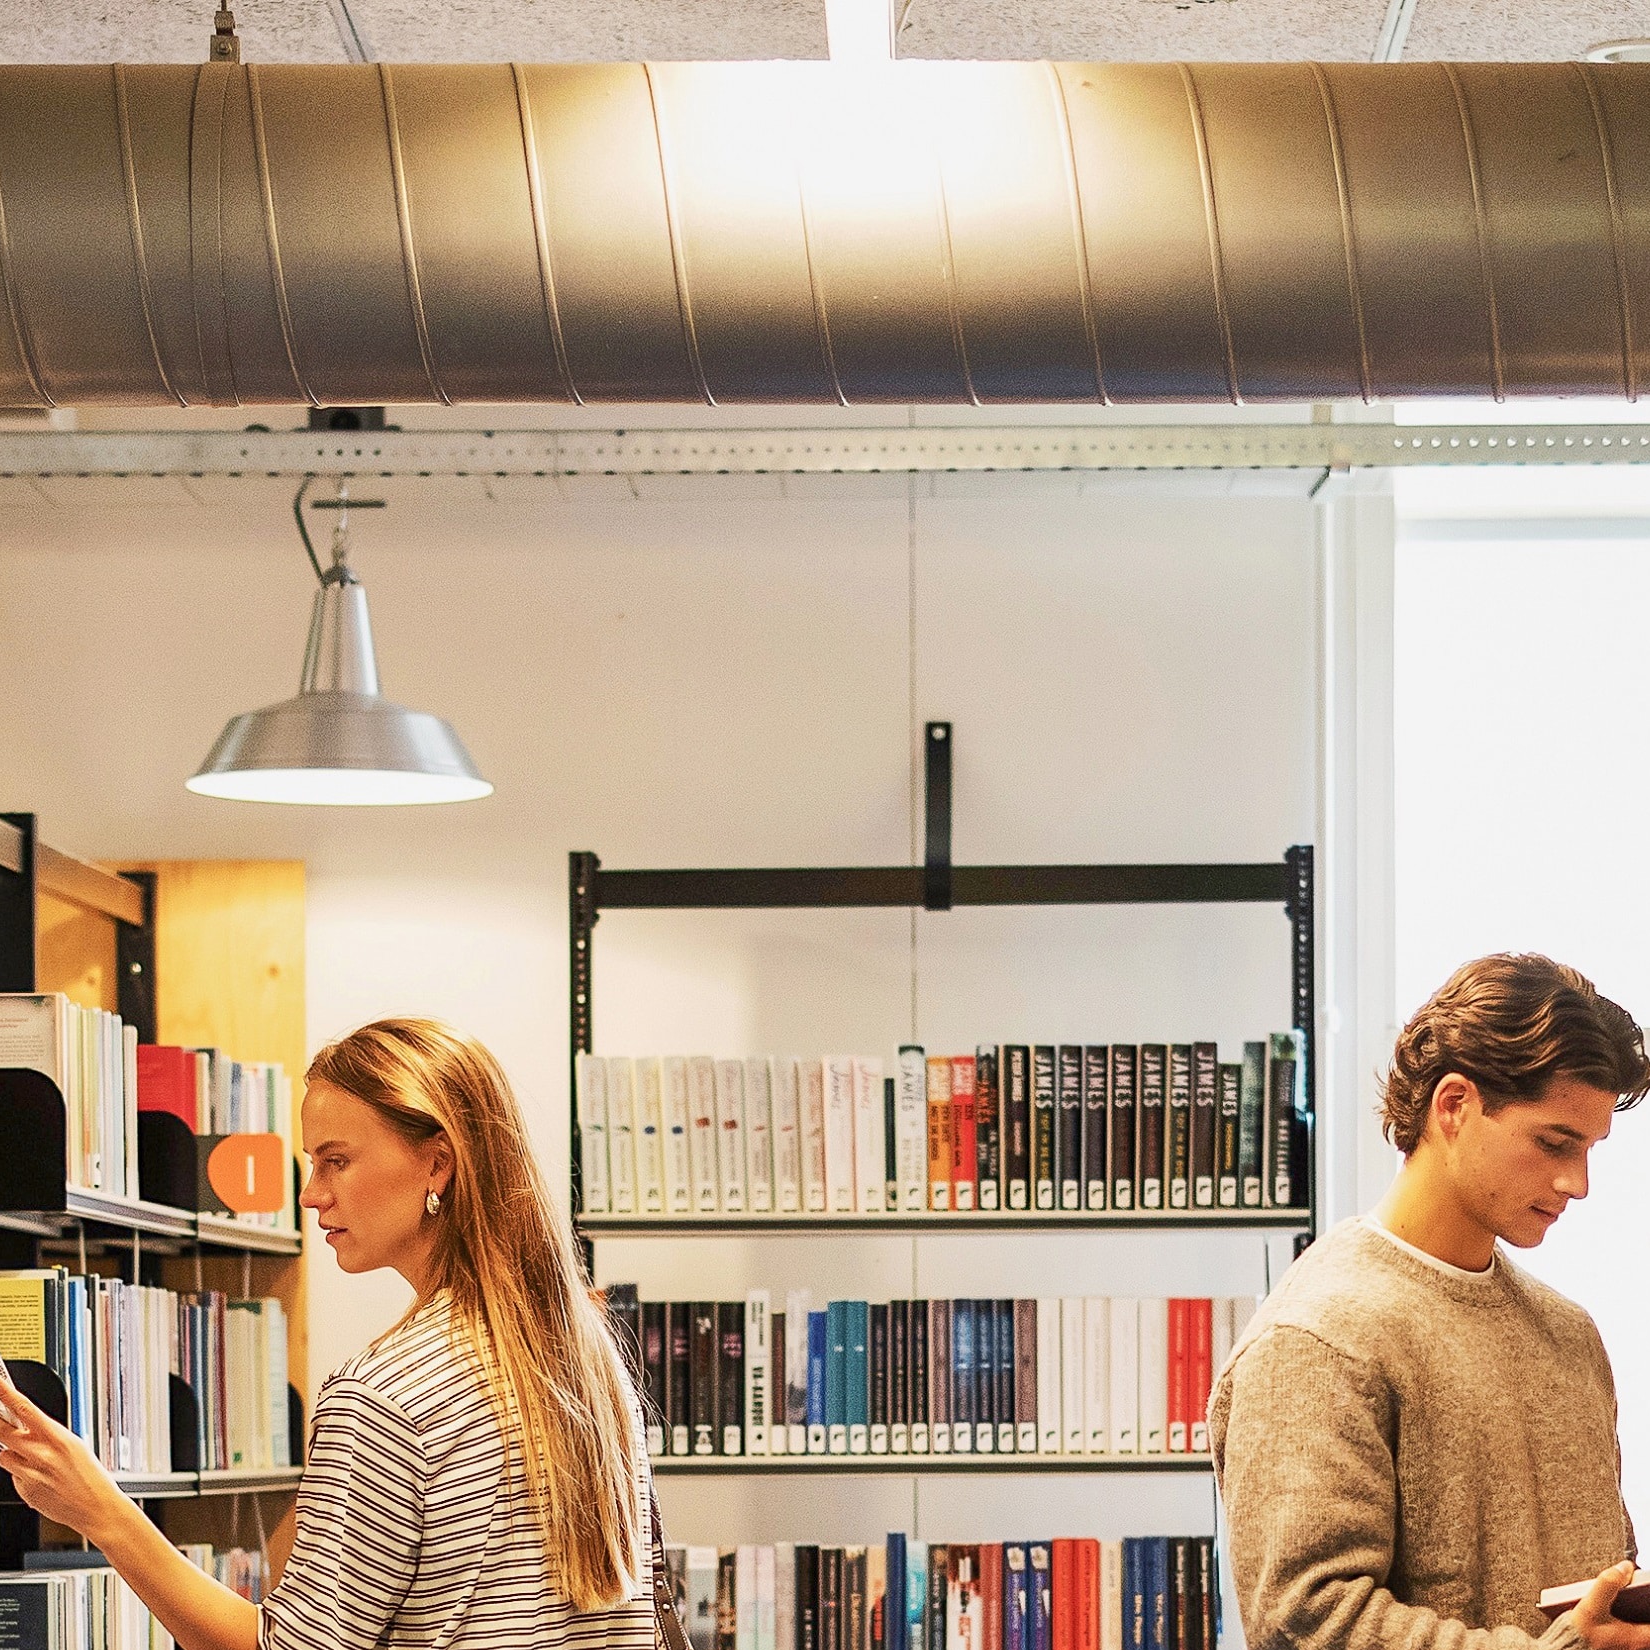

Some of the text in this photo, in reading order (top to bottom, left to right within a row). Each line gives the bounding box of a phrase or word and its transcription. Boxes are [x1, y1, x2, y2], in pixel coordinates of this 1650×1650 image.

[1036, 1054, 1053, 1109] JAMES
[1062, 1054, 1079, 1110] JAMES
[1088, 1054, 1104, 1109] JAMES
[1115, 1052, 1132, 1108] JAMES
[1143, 1051, 1161, 1107] JAMES
[1171, 1051, 1189, 1107] JAMES
[1197, 1051, 1215, 1107] JAMES
[1222, 1072, 1238, 1117] JAMES
